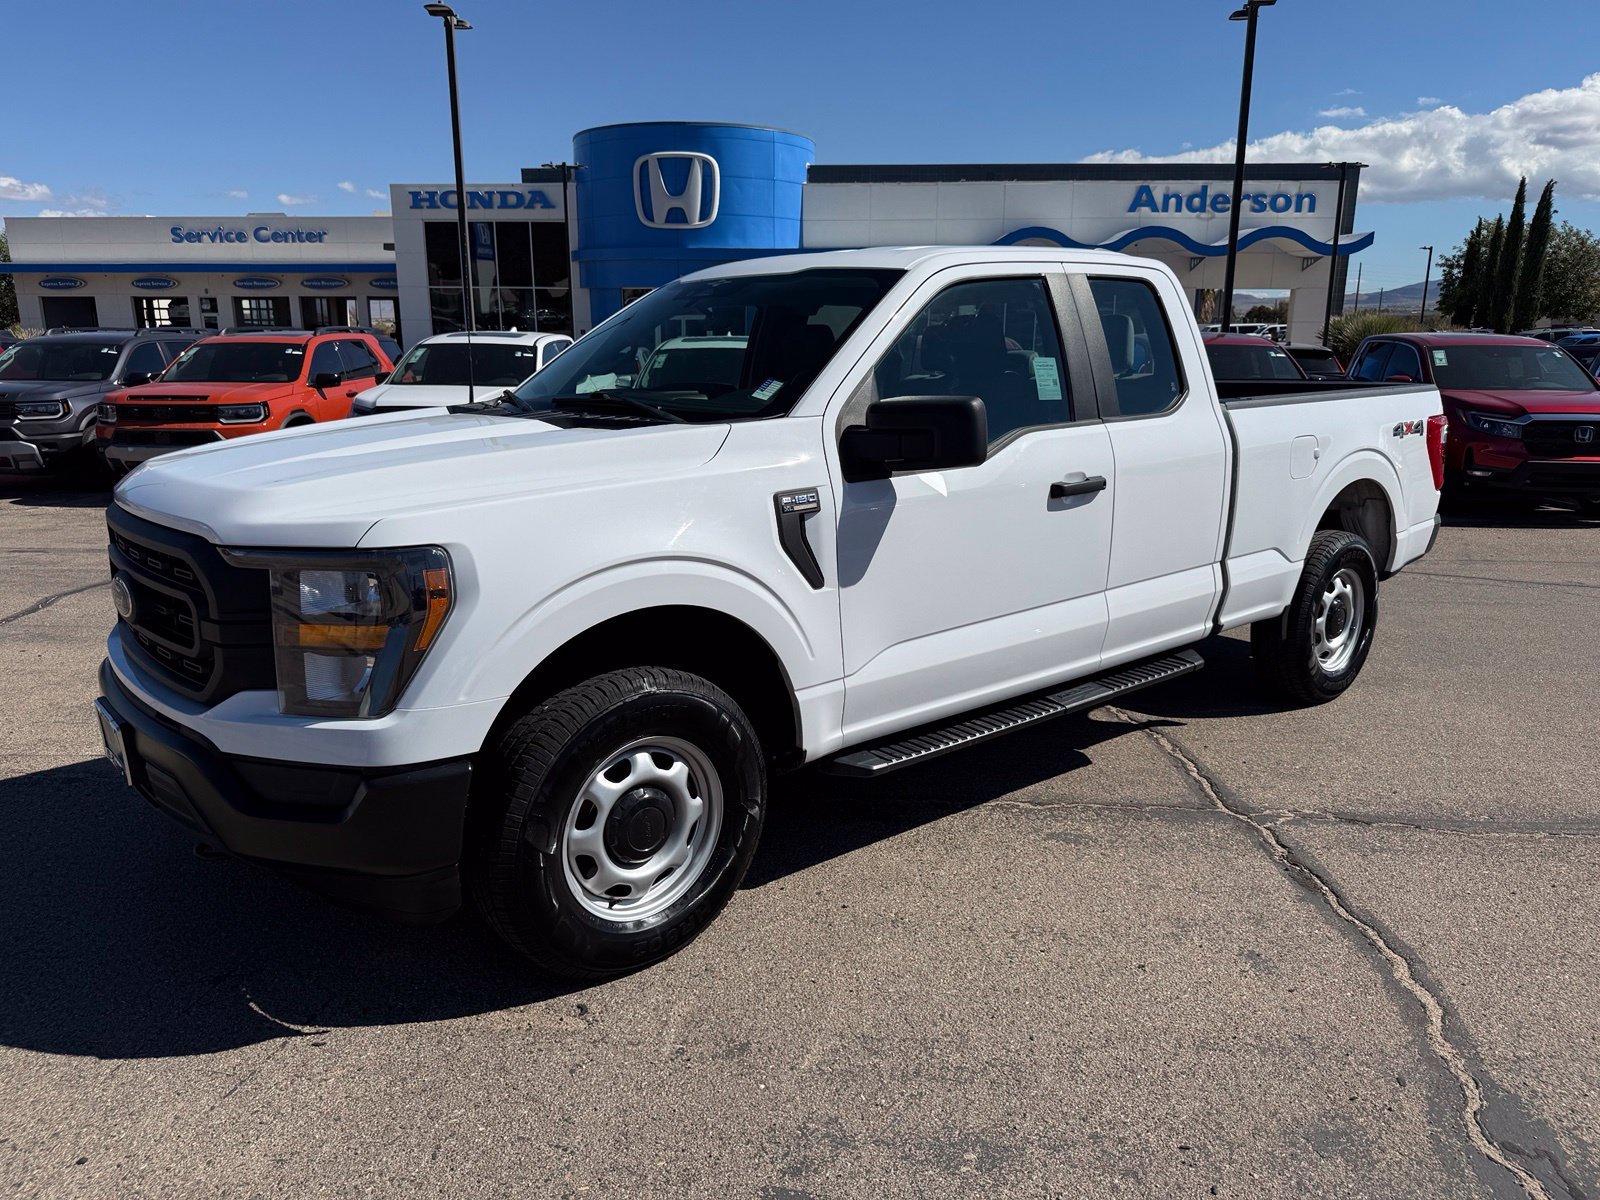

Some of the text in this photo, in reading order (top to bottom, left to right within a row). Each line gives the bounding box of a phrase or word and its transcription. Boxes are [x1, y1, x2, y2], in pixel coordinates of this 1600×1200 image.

[408, 190, 556, 210] HONDA
[170, 225, 328, 244] Service Center
